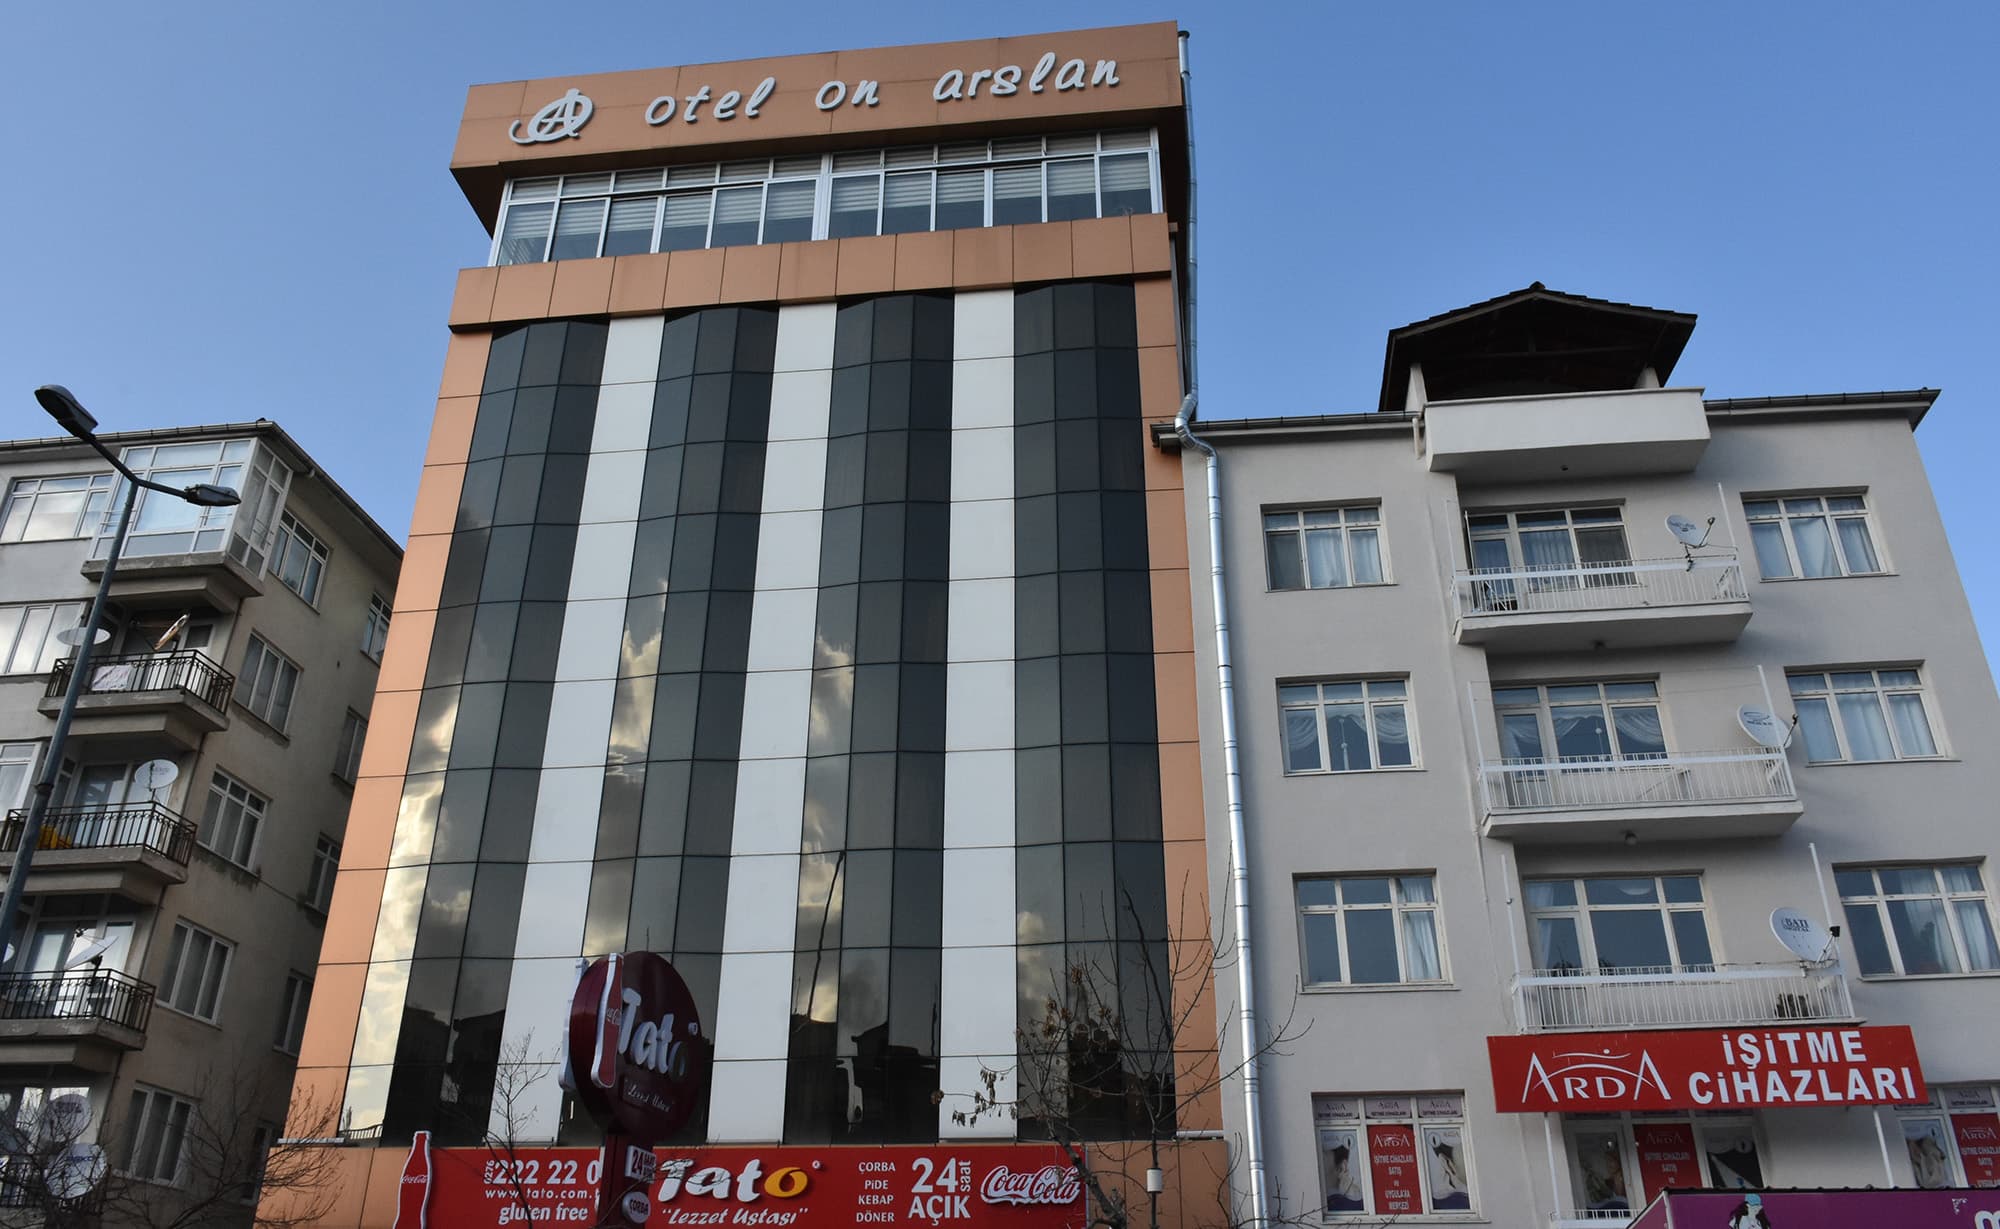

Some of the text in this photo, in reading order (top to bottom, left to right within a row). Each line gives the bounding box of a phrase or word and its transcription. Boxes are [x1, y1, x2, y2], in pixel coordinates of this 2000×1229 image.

[645, 52, 1120, 125] otel on arslan
[618, 987, 687, 1081] Tato
[1521, 1048, 1671, 1104] ARDA
[493, 1159, 540, 1185] 222
[546, 1159, 578, 1185] 22
[658, 1158, 808, 1202] Tato
[858, 1161, 896, 1175] ÇORBA
[911, 1157, 959, 1193] 24
[958, 1160, 972, 1192] saat
[555, 1202, 589, 1221] free
[856, 1209, 895, 1222] DÖNER
[858, 1194, 895, 1206] KEBAP
[907, 1194, 972, 1227] AÇIK
